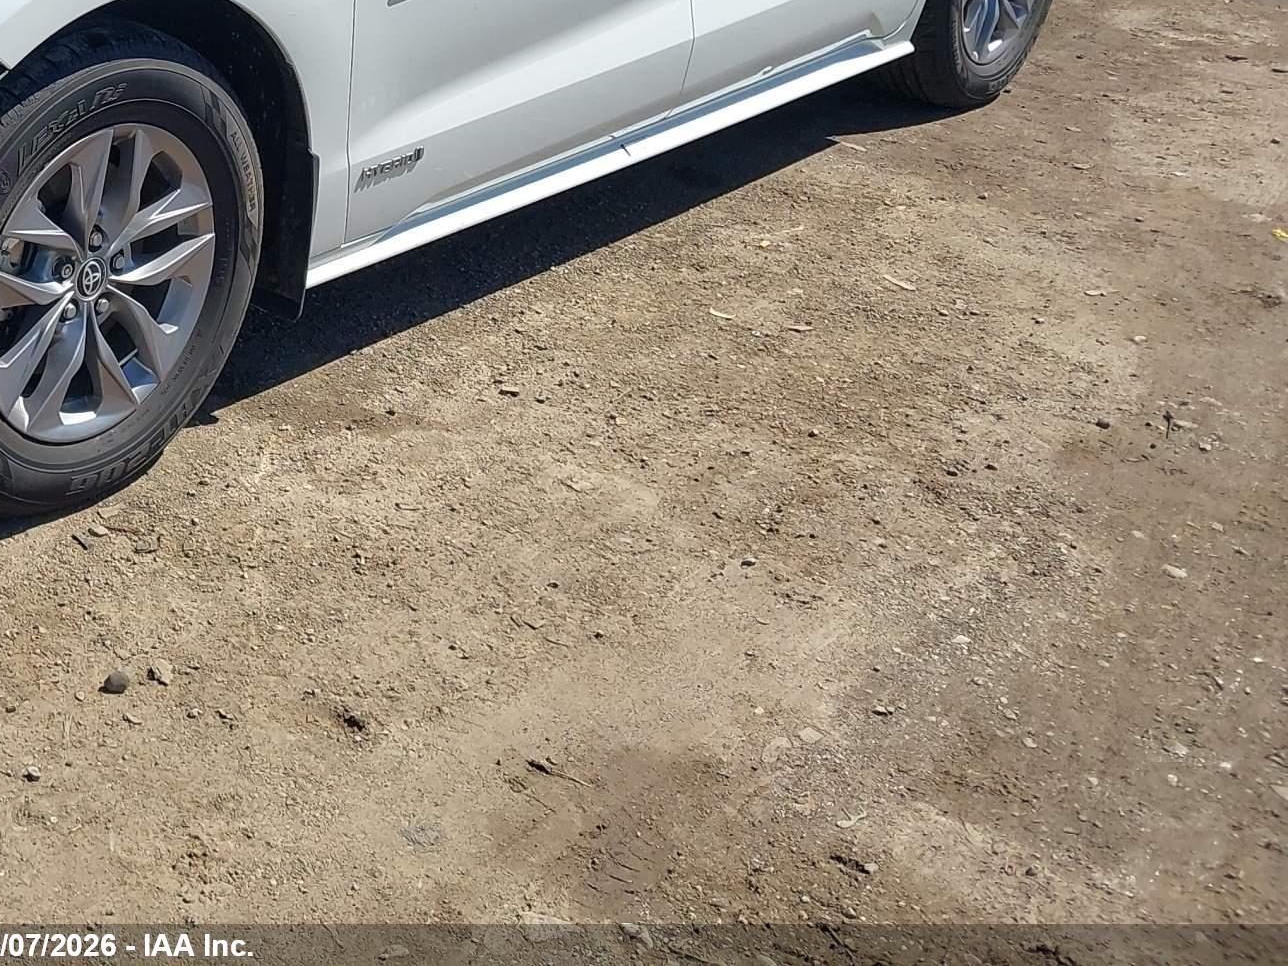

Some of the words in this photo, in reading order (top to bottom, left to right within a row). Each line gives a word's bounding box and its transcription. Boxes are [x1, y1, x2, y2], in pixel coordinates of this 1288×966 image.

[230, 131, 243, 153] ALL
[240, 153, 257, 212] WEATHER
[359, 145, 425, 186] HYBRID
